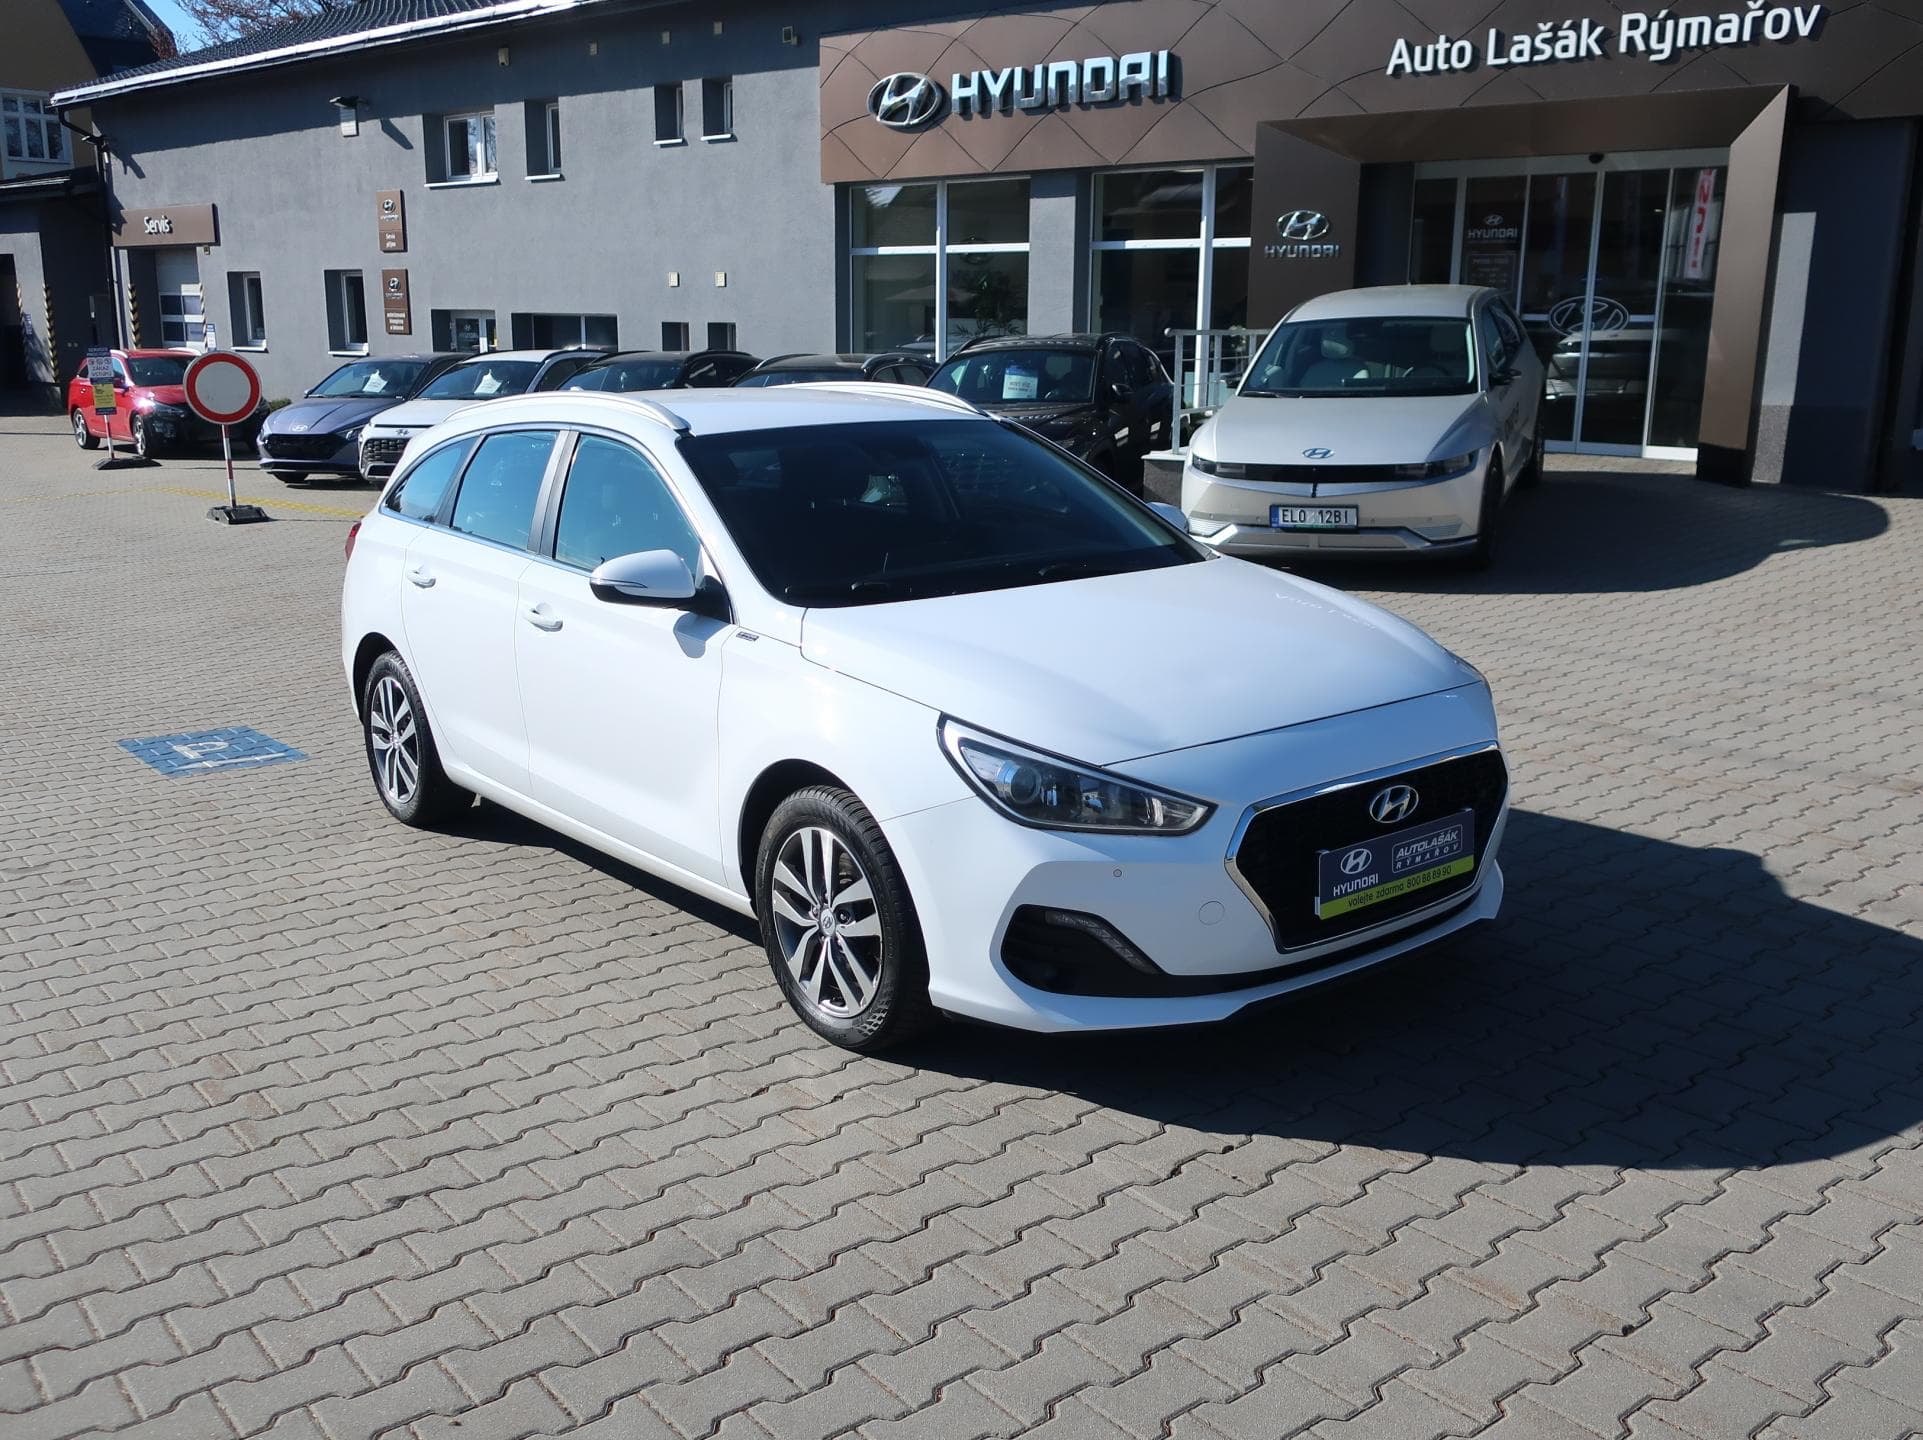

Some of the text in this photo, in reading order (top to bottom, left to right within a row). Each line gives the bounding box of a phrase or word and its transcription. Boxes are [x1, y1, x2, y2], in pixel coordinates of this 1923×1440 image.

[1386, 1, 1821, 75] Auto Lašák Rýmařov
[951, 49, 1170, 114] HYUNDAI
[143, 215, 170, 233] Servis
[1467, 227, 1518, 239] HYUNDAI
[1264, 244, 1340, 258] HYUNDAI
[1395, 843, 1459, 870] RÝMAŘOV
[1396, 829, 1459, 858] AUTOLAŠÁK
[1333, 873, 1379, 897] HYUNDAI
[1348, 893, 1373, 907] volejte
[1376, 880, 1404, 899] zdarma
